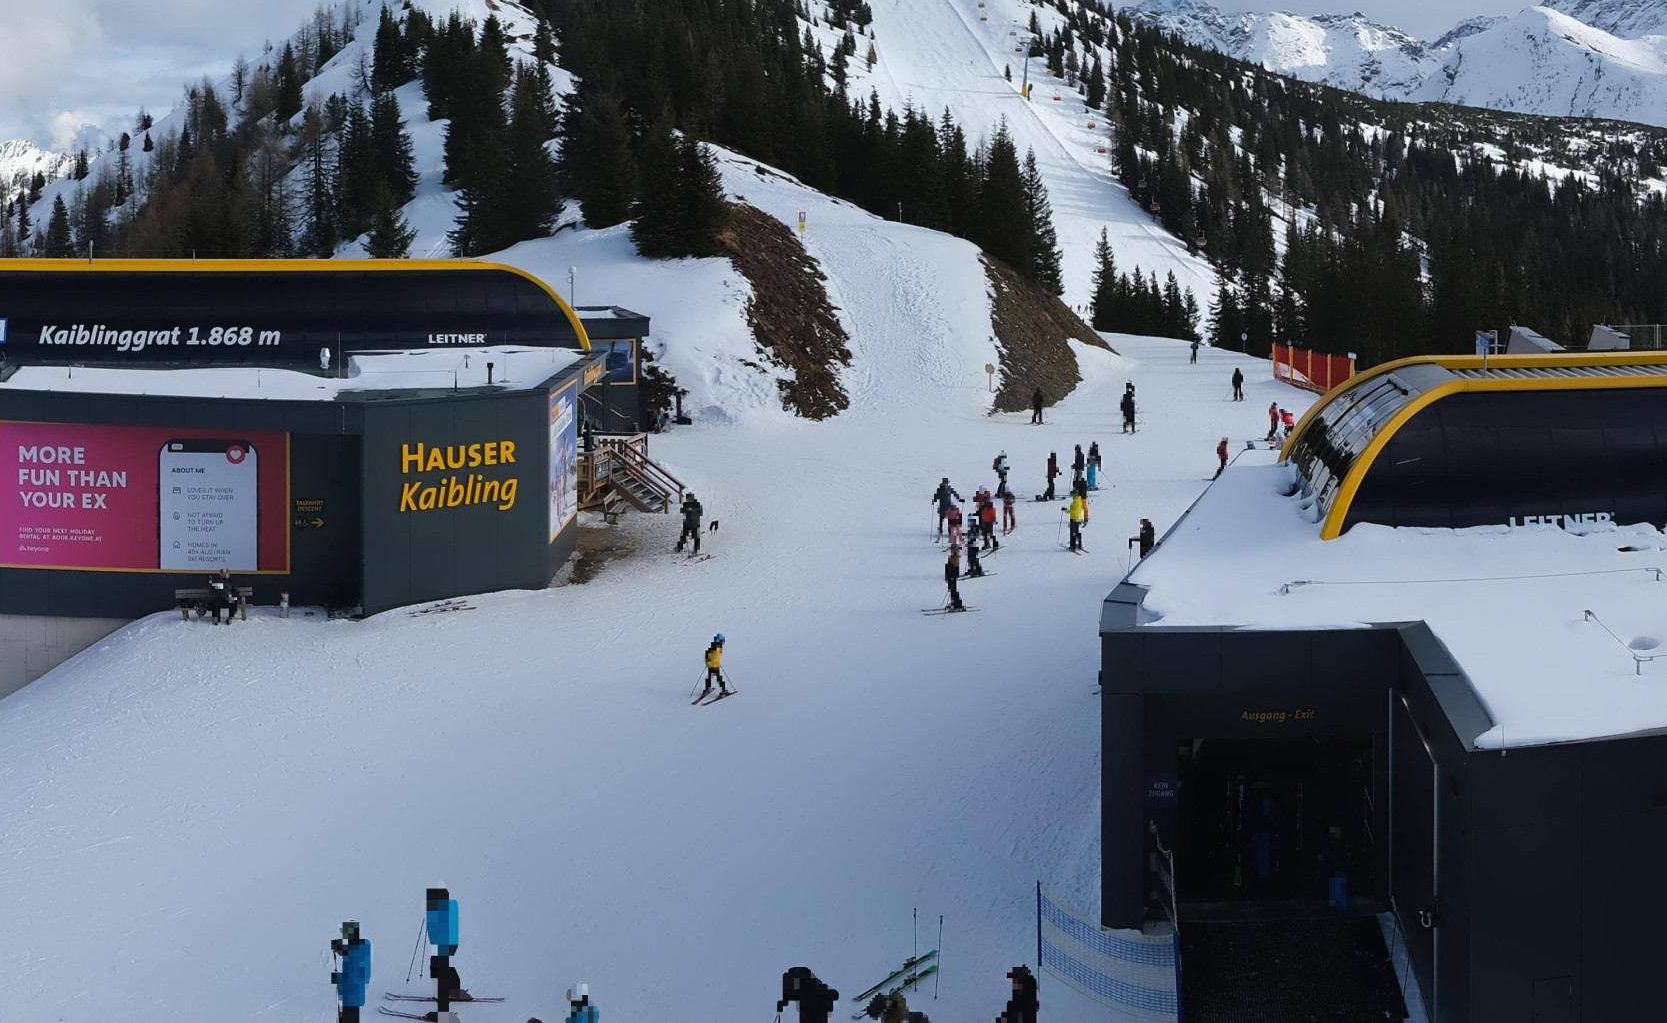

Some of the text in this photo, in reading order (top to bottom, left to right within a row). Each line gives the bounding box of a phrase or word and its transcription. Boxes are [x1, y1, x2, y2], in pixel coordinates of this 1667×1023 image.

[39, 324, 281, 352] Kaiblinggrat 1.868 m
[428, 333, 485, 344] LEITNER
[18, 445, 85, 465] MORE
[402, 440, 516, 474] HAUSER
[18, 468, 127, 488] FUN THAN
[20, 491, 107, 509] YOUR EX
[400, 474, 518, 512] Kaibling
[26, 545, 49, 553] keyone
[1242, 710, 1286, 723] Ausgang
[1295, 709, 1315, 720] Exit
[1154, 782, 1169, 790] KEIN
